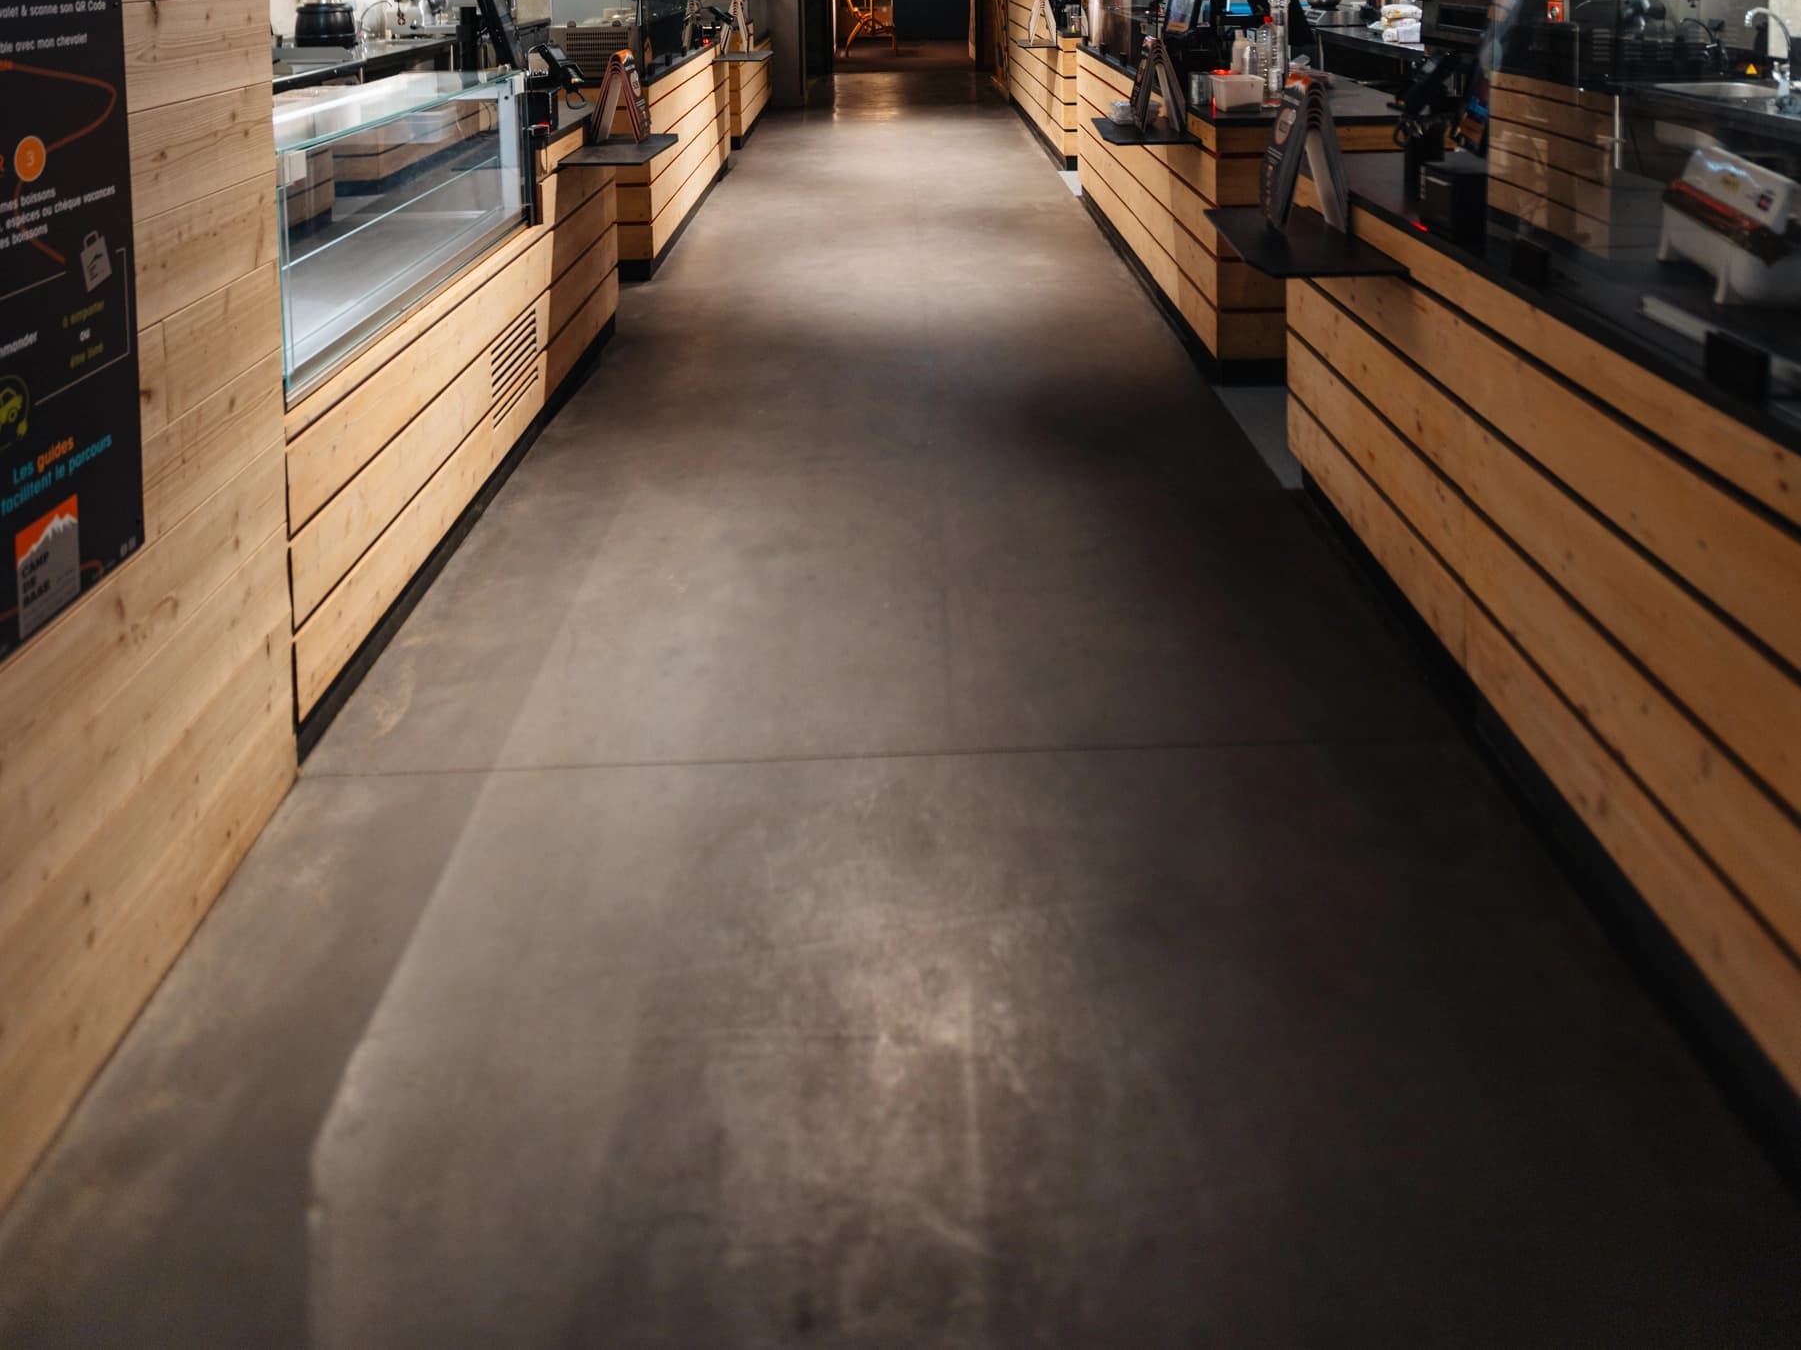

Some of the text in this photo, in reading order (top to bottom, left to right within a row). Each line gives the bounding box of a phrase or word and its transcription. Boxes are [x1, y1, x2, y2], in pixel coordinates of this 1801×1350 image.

[0, 5, 19, 18] valet
[75, 0, 86, 12] QR
[87, 0, 107, 12] Code
[15, 40, 35, 52] avec
[56, 33, 88, 47] chevalet
[12, 436, 75, 486] Les guides
[55, 462, 66, 482] le
[68, 433, 113, 476] parcours
